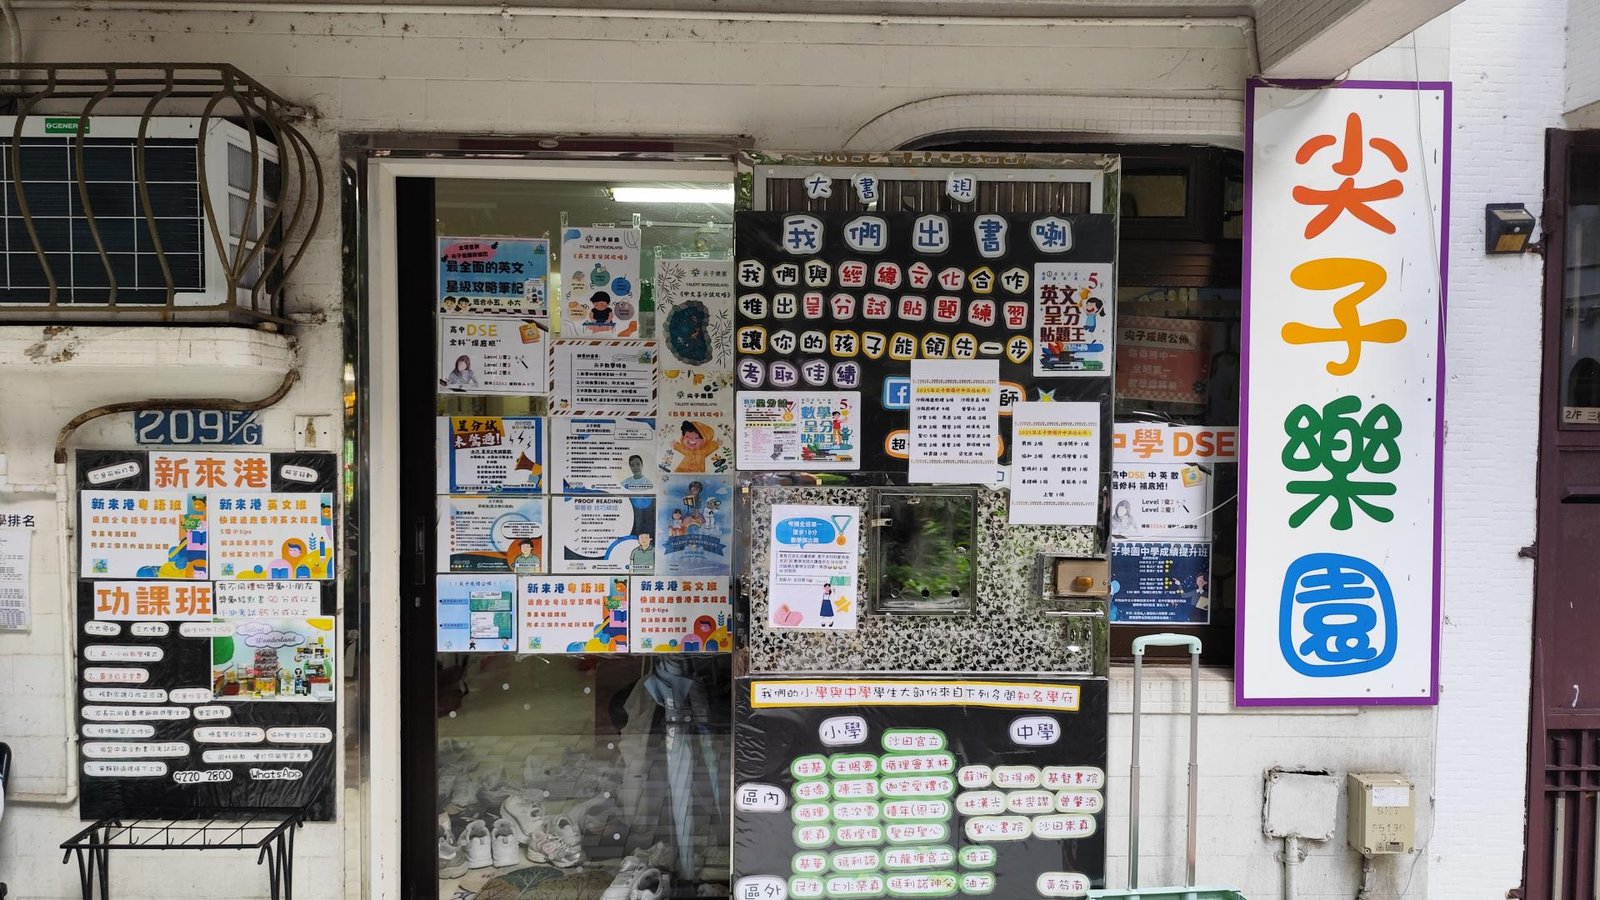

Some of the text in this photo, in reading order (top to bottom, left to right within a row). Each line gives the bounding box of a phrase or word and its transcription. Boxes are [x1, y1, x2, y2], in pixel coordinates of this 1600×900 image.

[787, 219, 1067, 252] 我們出書喇
[446, 260, 524, 274] 最全面的英文
[742, 265, 1025, 292] 我們與經緯文化合作
[1088, 272, 1098, 290] 5
[446, 280, 524, 294] 星級攻略筆記
[1040, 284, 1078, 305] 英文
[742, 296, 1026, 326] 推出呈分試貼題練習
[1044, 306, 1081, 326] 呈分
[1040, 327, 1086, 342] 貼題王
[741, 331, 1030, 358] 讓你的孩子能領先一步
[742, 362, 858, 385] 考取佳績
[1281, 112, 1408, 677] 尖子樂園
[839, 399, 848, 410] 5
[801, 406, 831, 419] 數學
[1565, 410, 1582, 420] 2/F
[139, 410, 224, 444] 209
[803, 421, 833, 432] 呈分
[800, 433, 836, 444] 貼題王
[1173, 431, 1235, 458] DSE
[154, 456, 270, 489] 新來港
[1148, 471, 1157, 479] 中
[1159, 472, 1168, 480] 英
[1171, 472, 1179, 480] 數
[97, 586, 212, 616] 功課班
[255, 635, 296, 644] Wonderland
[824, 722, 861, 741] 小學
[1016, 722, 1054, 741] 中學
[889, 735, 939, 747] 沙田官立
[798, 761, 823, 774] 培基
[885, 758, 949, 771] 循理會美林
[174, 770, 232, 782] 9220 2800
[251, 768, 302, 779] WhatsApp
[963, 771, 988, 782] 蘇浙
[998, 772, 1036, 783] 郭得勝
[1047, 772, 1099, 784] 基督書院
[799, 784, 825, 796] 培僑
[885, 780, 949, 792] 迦密愛禮信
[743, 789, 779, 806] 區內
[799, 806, 825, 818] 循理
[974, 821, 1024, 834] 聖心書院
[837, 854, 876, 866] 瑪利諾
[887, 852, 950, 865] 九龍塘官立
[966, 851, 990, 862] 培正
[799, 857, 823, 870] 基華
[890, 878, 954, 890] 瑪利諾神父
[966, 877, 990, 888] 油天
[744, 883, 782, 900] 區外
